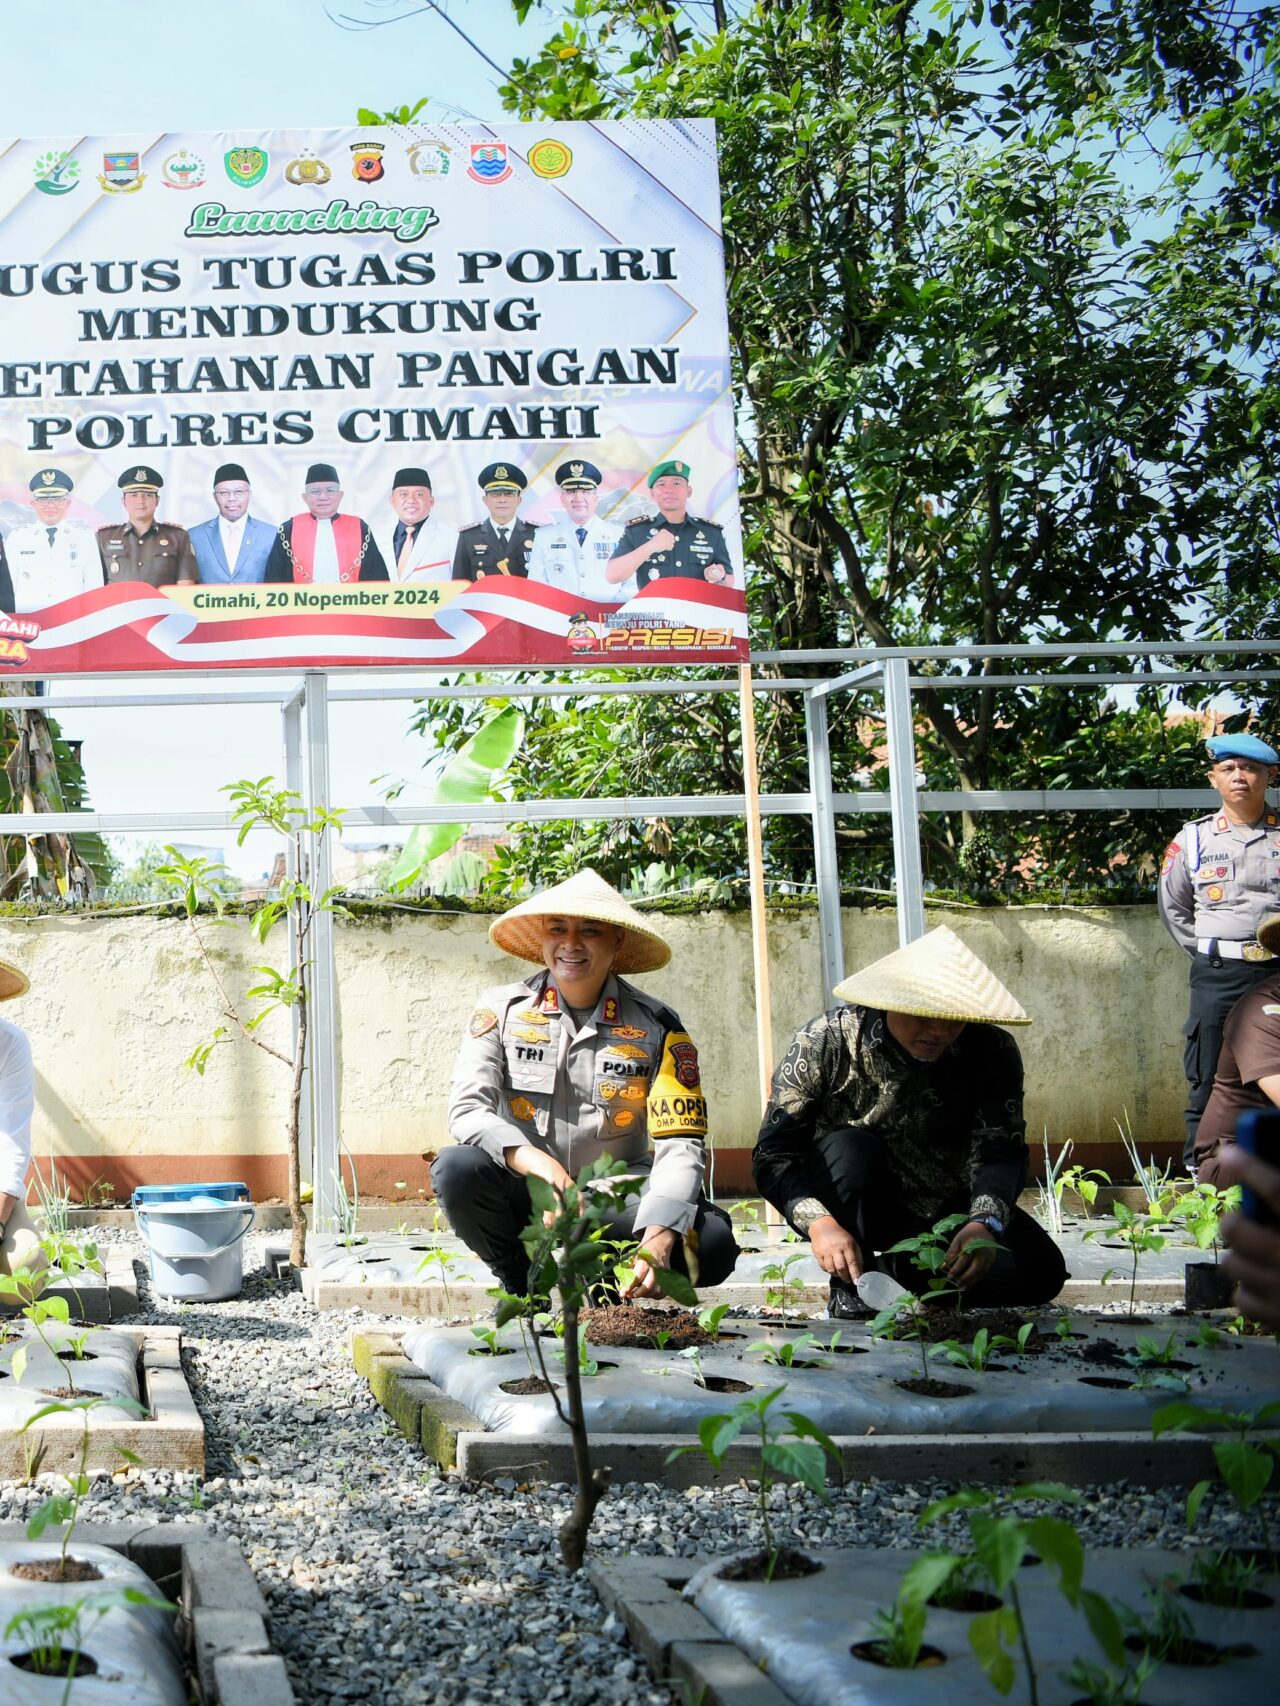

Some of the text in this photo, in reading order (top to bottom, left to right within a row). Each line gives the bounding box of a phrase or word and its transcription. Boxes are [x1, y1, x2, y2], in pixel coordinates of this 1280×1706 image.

[184, 199, 440, 243] Launching
[203, 250, 436, 291] TUGAS
[457, 245, 678, 284] POLRI
[78, 296, 543, 342] MENDUKUNG
[396, 346, 681, 389] PANGAN
[27, 404, 602, 451] POLRES CIMAHI
[193, 589, 440, 610] Cimahi, 20 Nopember 2024
[638, 620, 663, 629] POLRI
[664, 620, 686, 629] YANG
[605, 628, 735, 646] PRESISI
[515, 1046, 544, 1062] TRI
[603, 1061, 650, 1077] POLRI
[650, 1098, 671, 1118] KA
